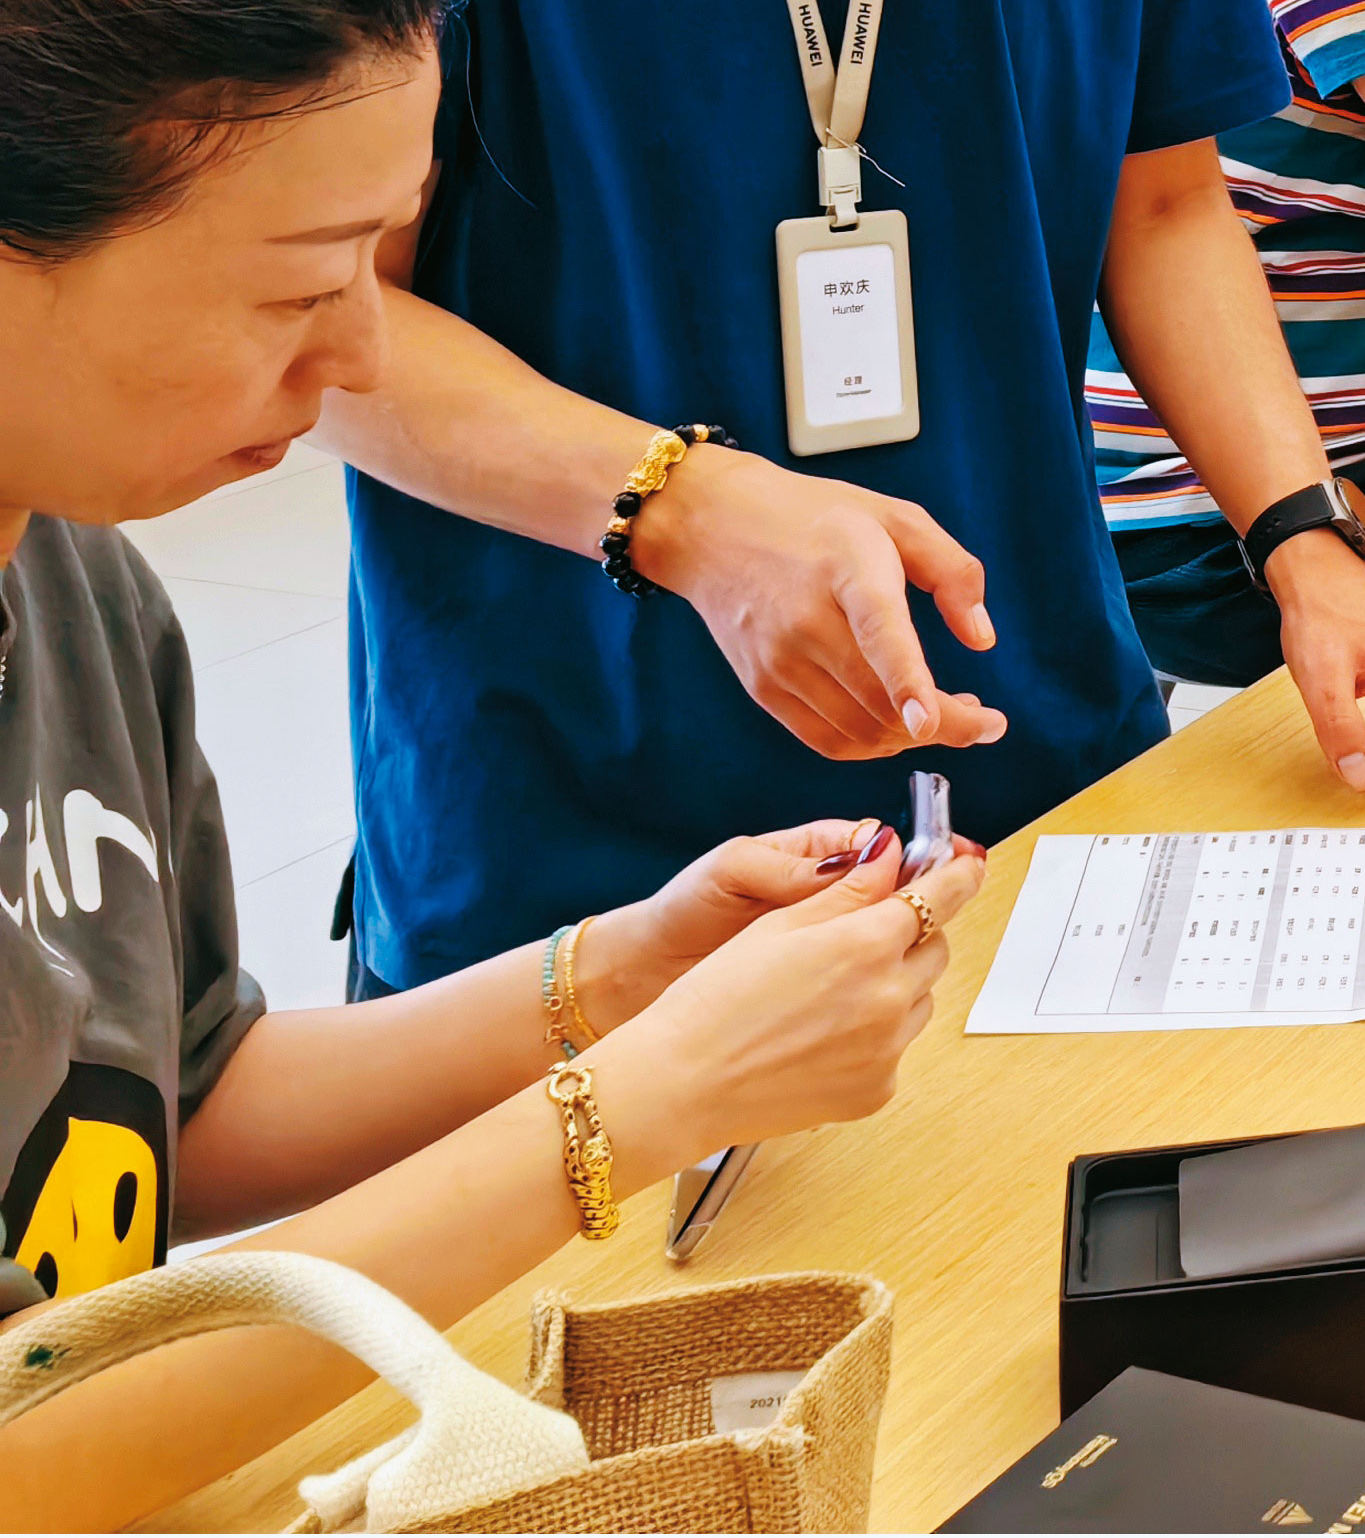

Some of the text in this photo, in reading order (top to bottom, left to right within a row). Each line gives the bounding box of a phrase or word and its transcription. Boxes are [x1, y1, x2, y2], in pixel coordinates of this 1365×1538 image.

[798, 3, 823, 67] HUAWEI
[850, 2, 873, 65] HUAWEI
[823, 278, 871, 298] 申欢庆
[832, 304, 865, 316] Hunter
[749, 1394, 787, 1409] 2021
